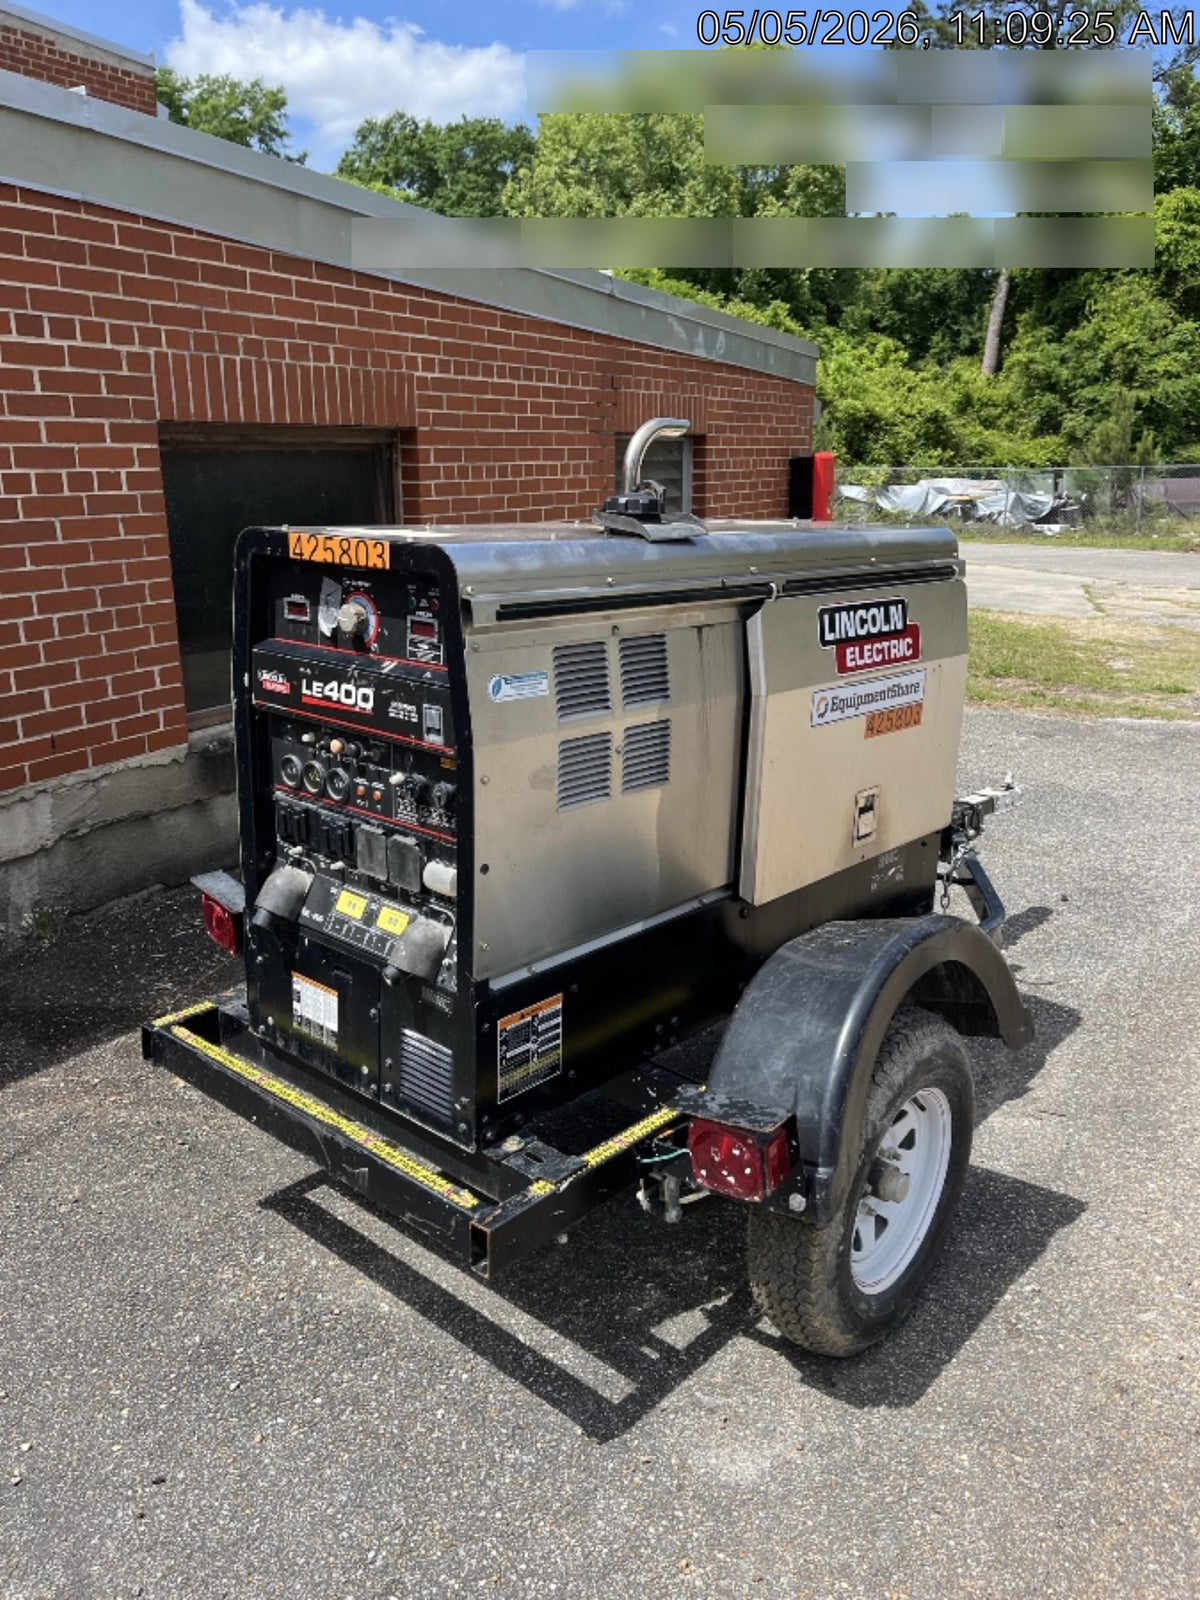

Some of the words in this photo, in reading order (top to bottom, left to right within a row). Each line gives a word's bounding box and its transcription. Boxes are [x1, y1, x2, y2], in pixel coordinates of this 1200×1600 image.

[292, 533, 386, 569] 425803
[823, 603, 904, 641] LINCOLN
[845, 637, 913, 668] ELECTRIC
[301, 678, 374, 709] LE400
[830, 681, 920, 714] EquipmentShare
[866, 703, 922, 736] 425803
